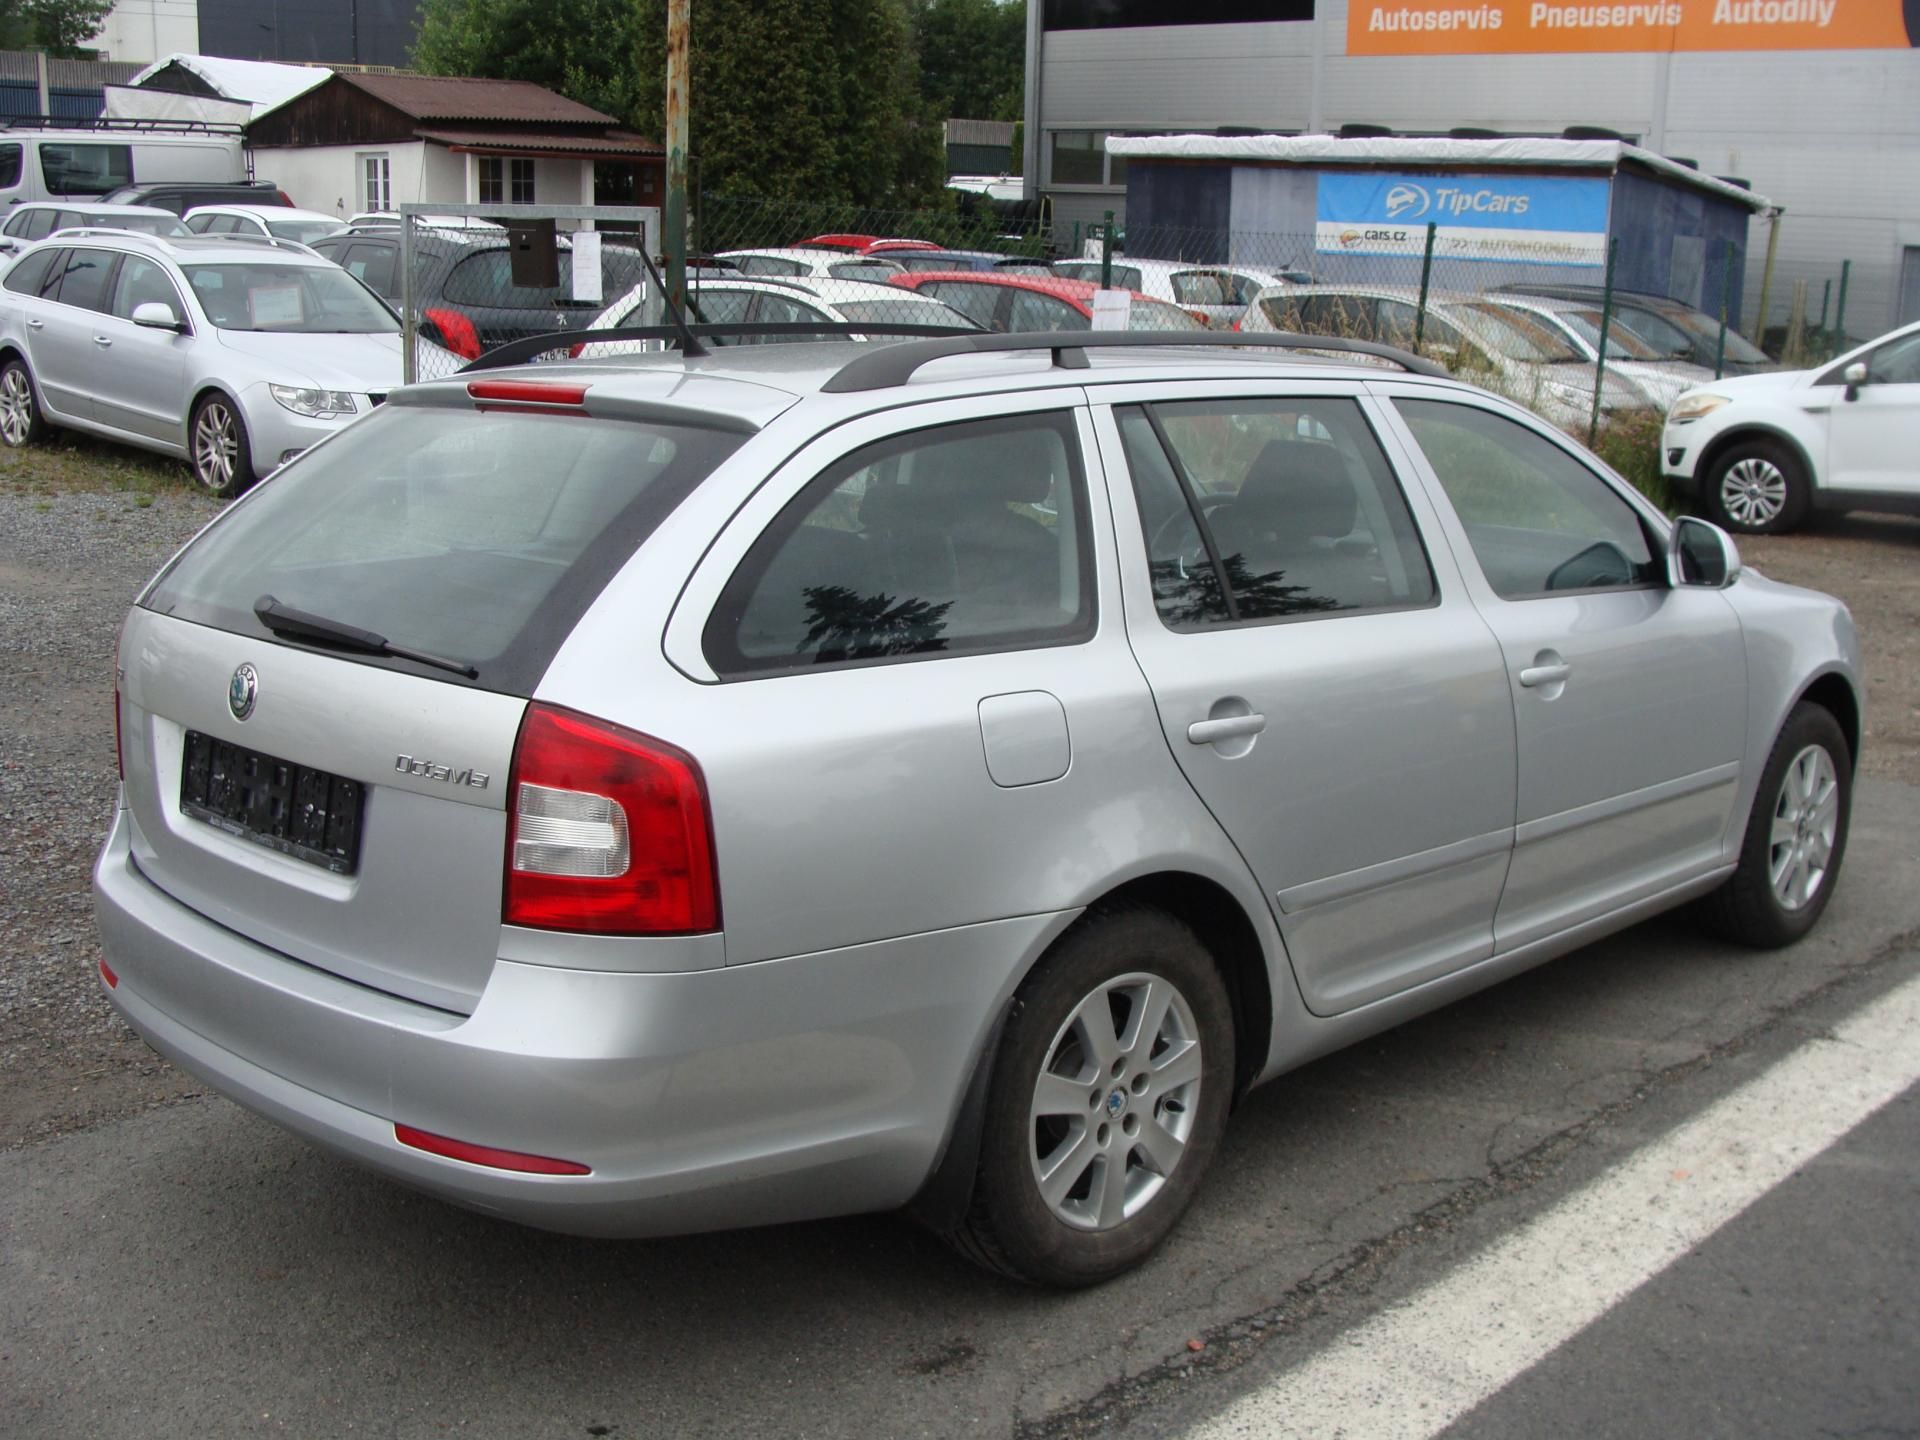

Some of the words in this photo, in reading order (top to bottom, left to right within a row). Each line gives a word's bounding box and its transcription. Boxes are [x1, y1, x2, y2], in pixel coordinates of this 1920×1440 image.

[1368, 5, 1503, 32] Autoservis
[1529, 0, 1682, 28] Pneuservis
[1436, 188, 1530, 217] TipCars
[1364, 229, 1407, 241] cars.cz
[395, 754, 490, 789] Octavia
